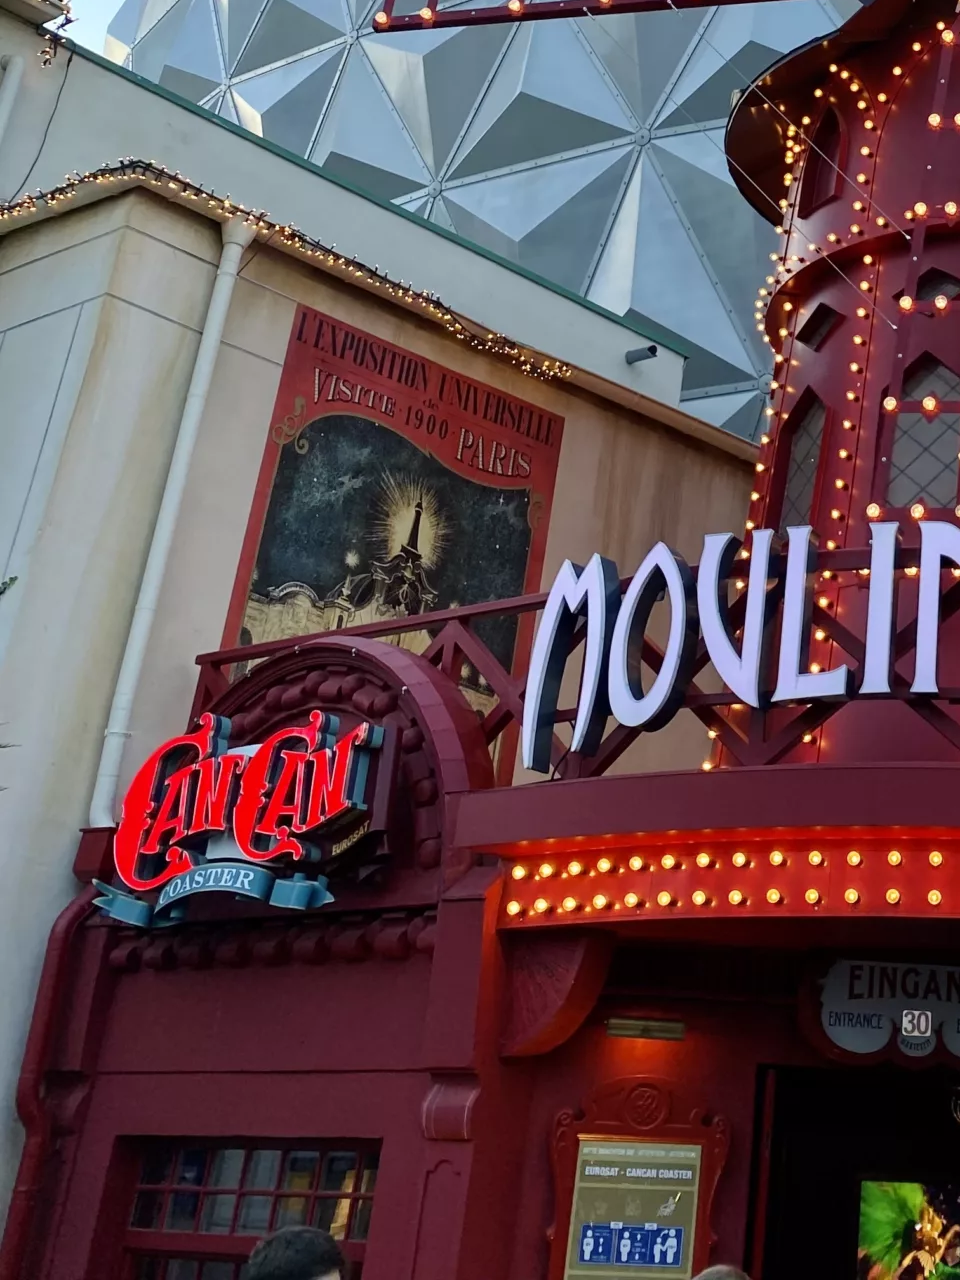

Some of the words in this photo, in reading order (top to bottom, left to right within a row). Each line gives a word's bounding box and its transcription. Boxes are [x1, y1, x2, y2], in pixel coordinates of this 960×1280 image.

[296, 312, 430, 393] L'EXPOSITION
[438, 372, 557, 446] UNIVERSELLE
[313, 366, 396, 418] VISITE
[404, 405, 449, 440] 1900
[456, 426, 532, 478] PARIS
[332, 820, 370, 856] EUROSAT
[159, 867, 255, 905] COASTER
[828, 1011, 884, 1030] ENTRANCE
[903, 1011, 930, 1035] 30
[585, 1166, 620, 1177] EUROSAT
[626, 1168, 657, 1178] CANCAN
[658, 1170, 693, 1179] COASTER
